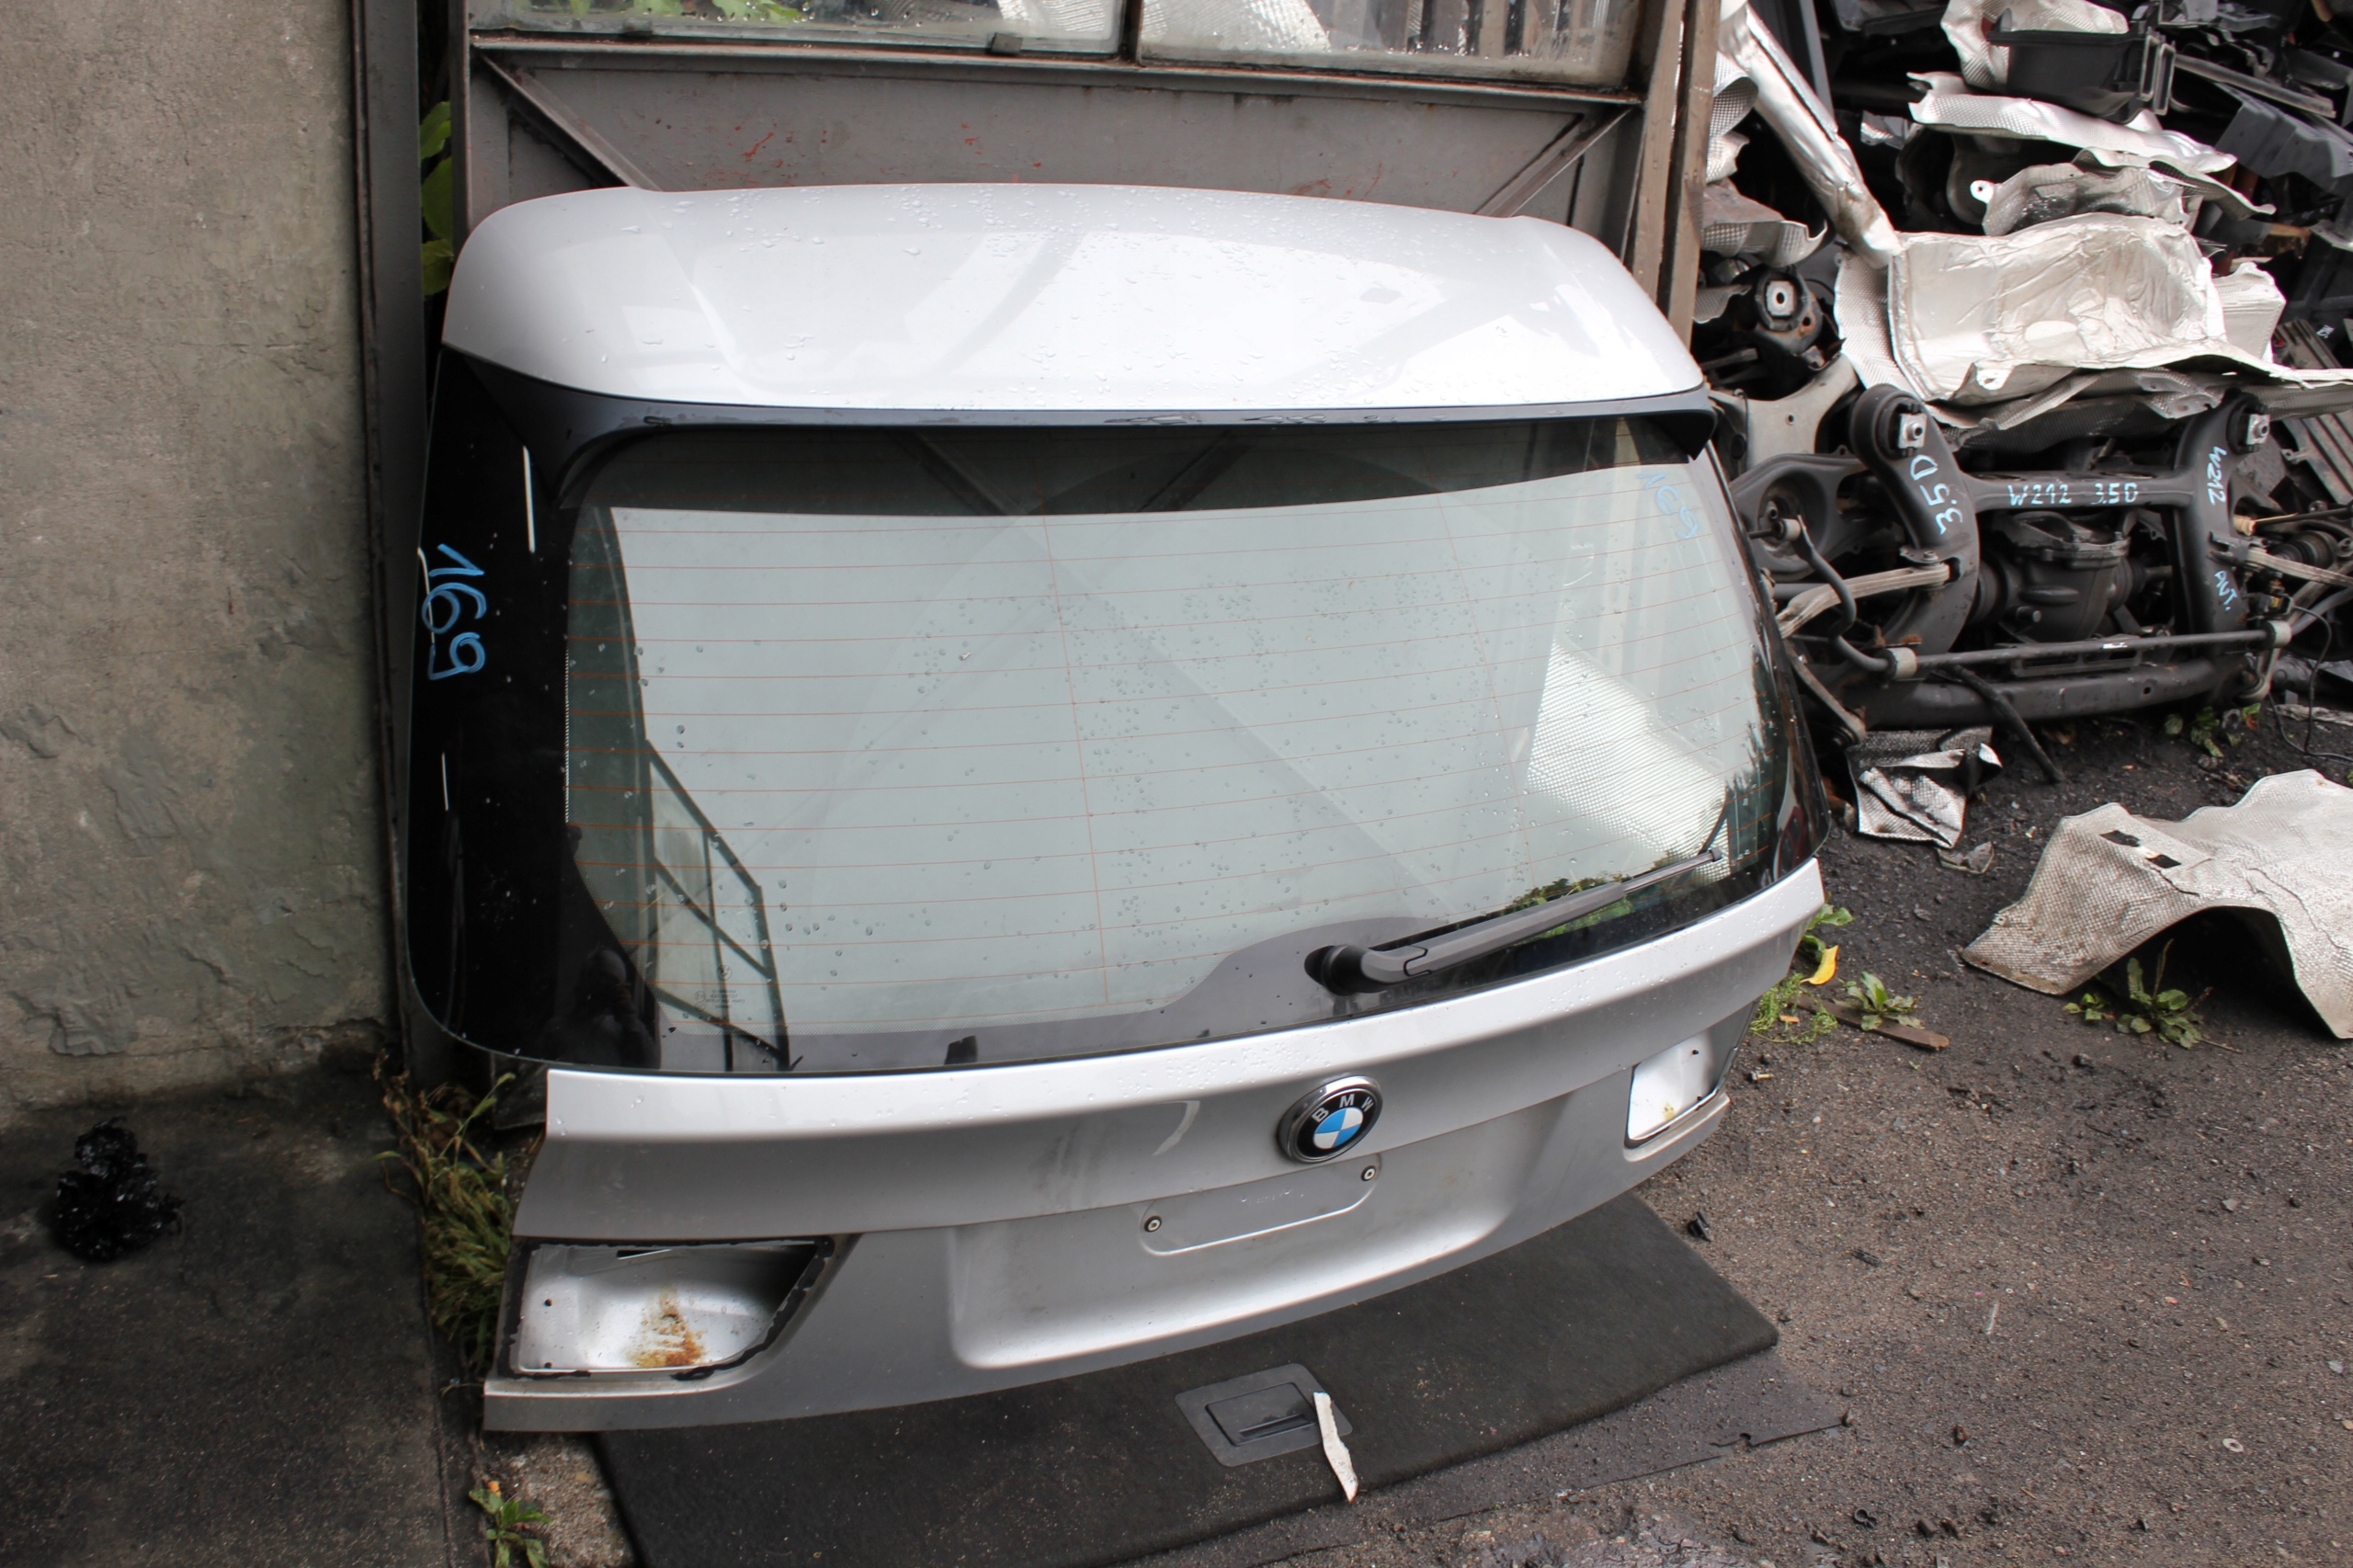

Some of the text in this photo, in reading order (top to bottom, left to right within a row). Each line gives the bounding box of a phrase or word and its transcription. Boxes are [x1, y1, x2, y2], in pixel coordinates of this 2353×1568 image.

[1635, 472, 1699, 539] 169
[2006, 482, 2073, 506] W212
[2206, 446, 2227, 506] W212
[422, 543, 487, 680] 169
[1312, 1093, 1375, 1123] BMW
